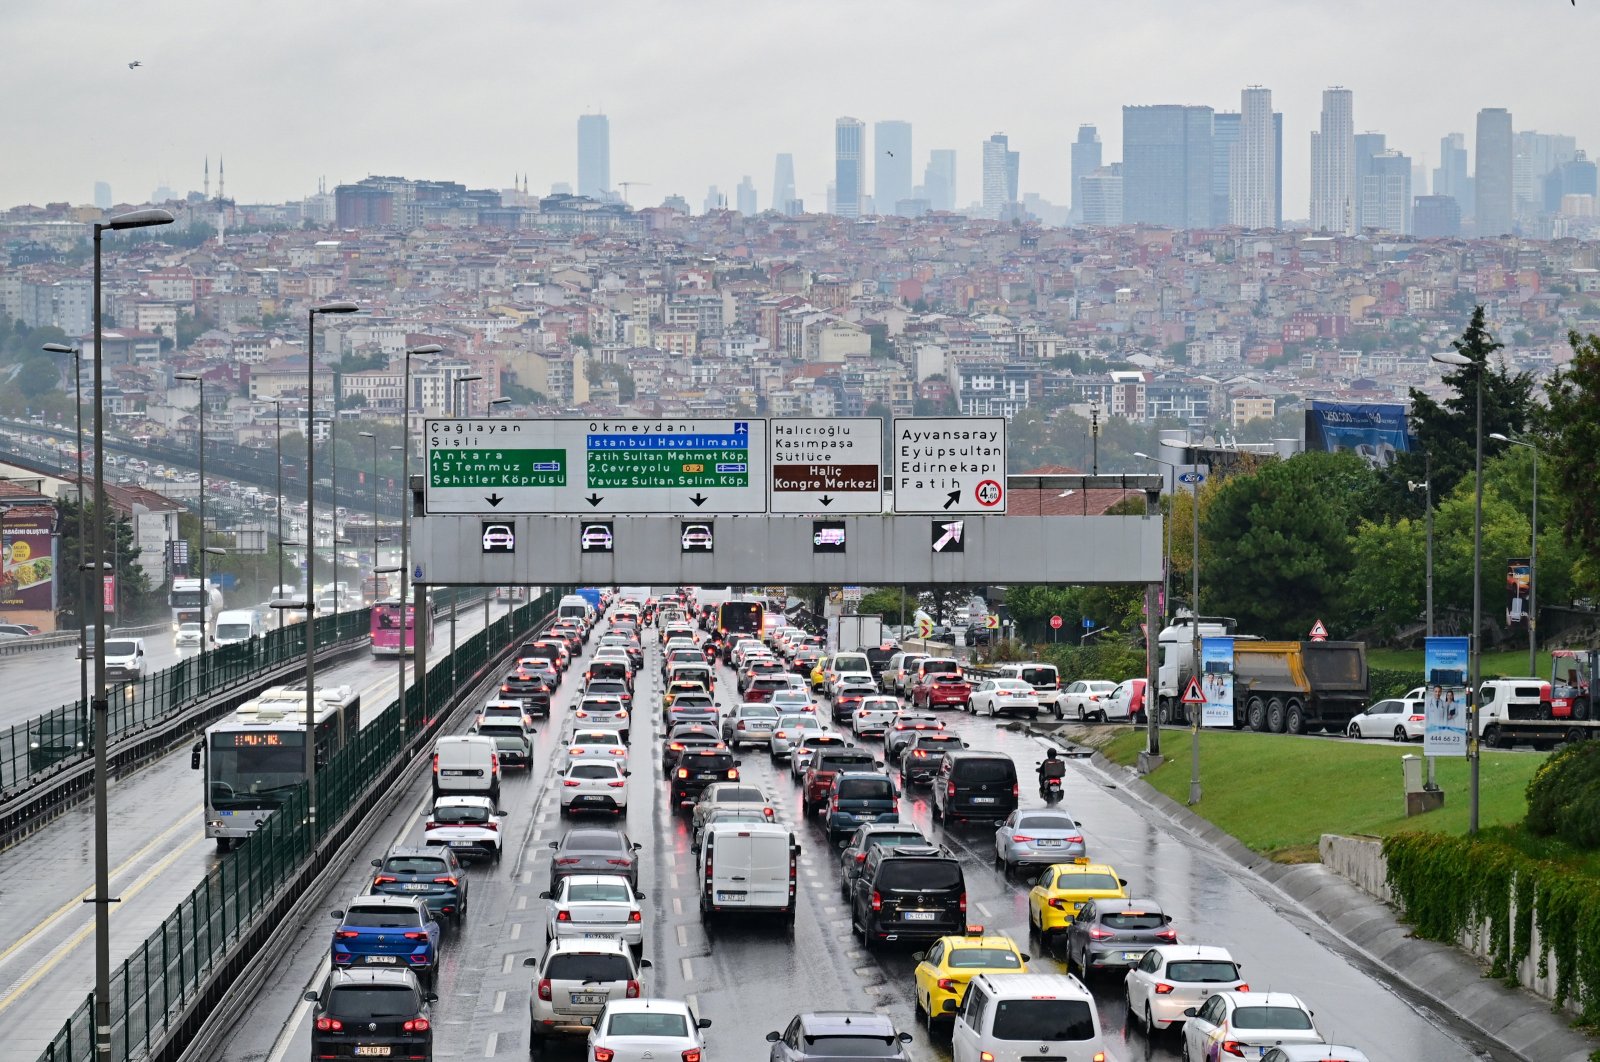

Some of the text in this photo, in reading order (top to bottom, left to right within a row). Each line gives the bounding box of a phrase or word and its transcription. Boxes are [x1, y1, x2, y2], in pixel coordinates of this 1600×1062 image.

[431, 423, 521, 434] Çağlayan
[589, 422, 695, 434] Okmeydanı
[775, 425, 850, 437] Halıcıoğlu
[588, 436, 744, 447] İstanbul Havalimanı
[902, 429, 998, 443] Ayvansaray
[431, 437, 478, 447] Şişli
[775, 439, 853, 450] Kasımpaşa
[432, 451, 503, 460] Ankara
[588, 451, 747, 462] Fatih Sultan Mehmet Köp.
[776, 453, 832, 461] Sütlüce
[901, 445, 1001, 459] Eyüpsultan
[433, 462, 520, 471] 15 Temmuz
[588, 463, 670, 474] 2.Çevreyolu
[809, 466, 842, 477] Haliç
[901, 462, 996, 475] Edirnekapı
[433, 475, 565, 485] Şehitler Köprüsü
[588, 476, 747, 487] Yavuz Sultan Selim Köp.
[775, 478, 876, 491] Kongre Merkezi
[901, 478, 960, 489] Fatih
[1452, 735, 1460, 743] 23
